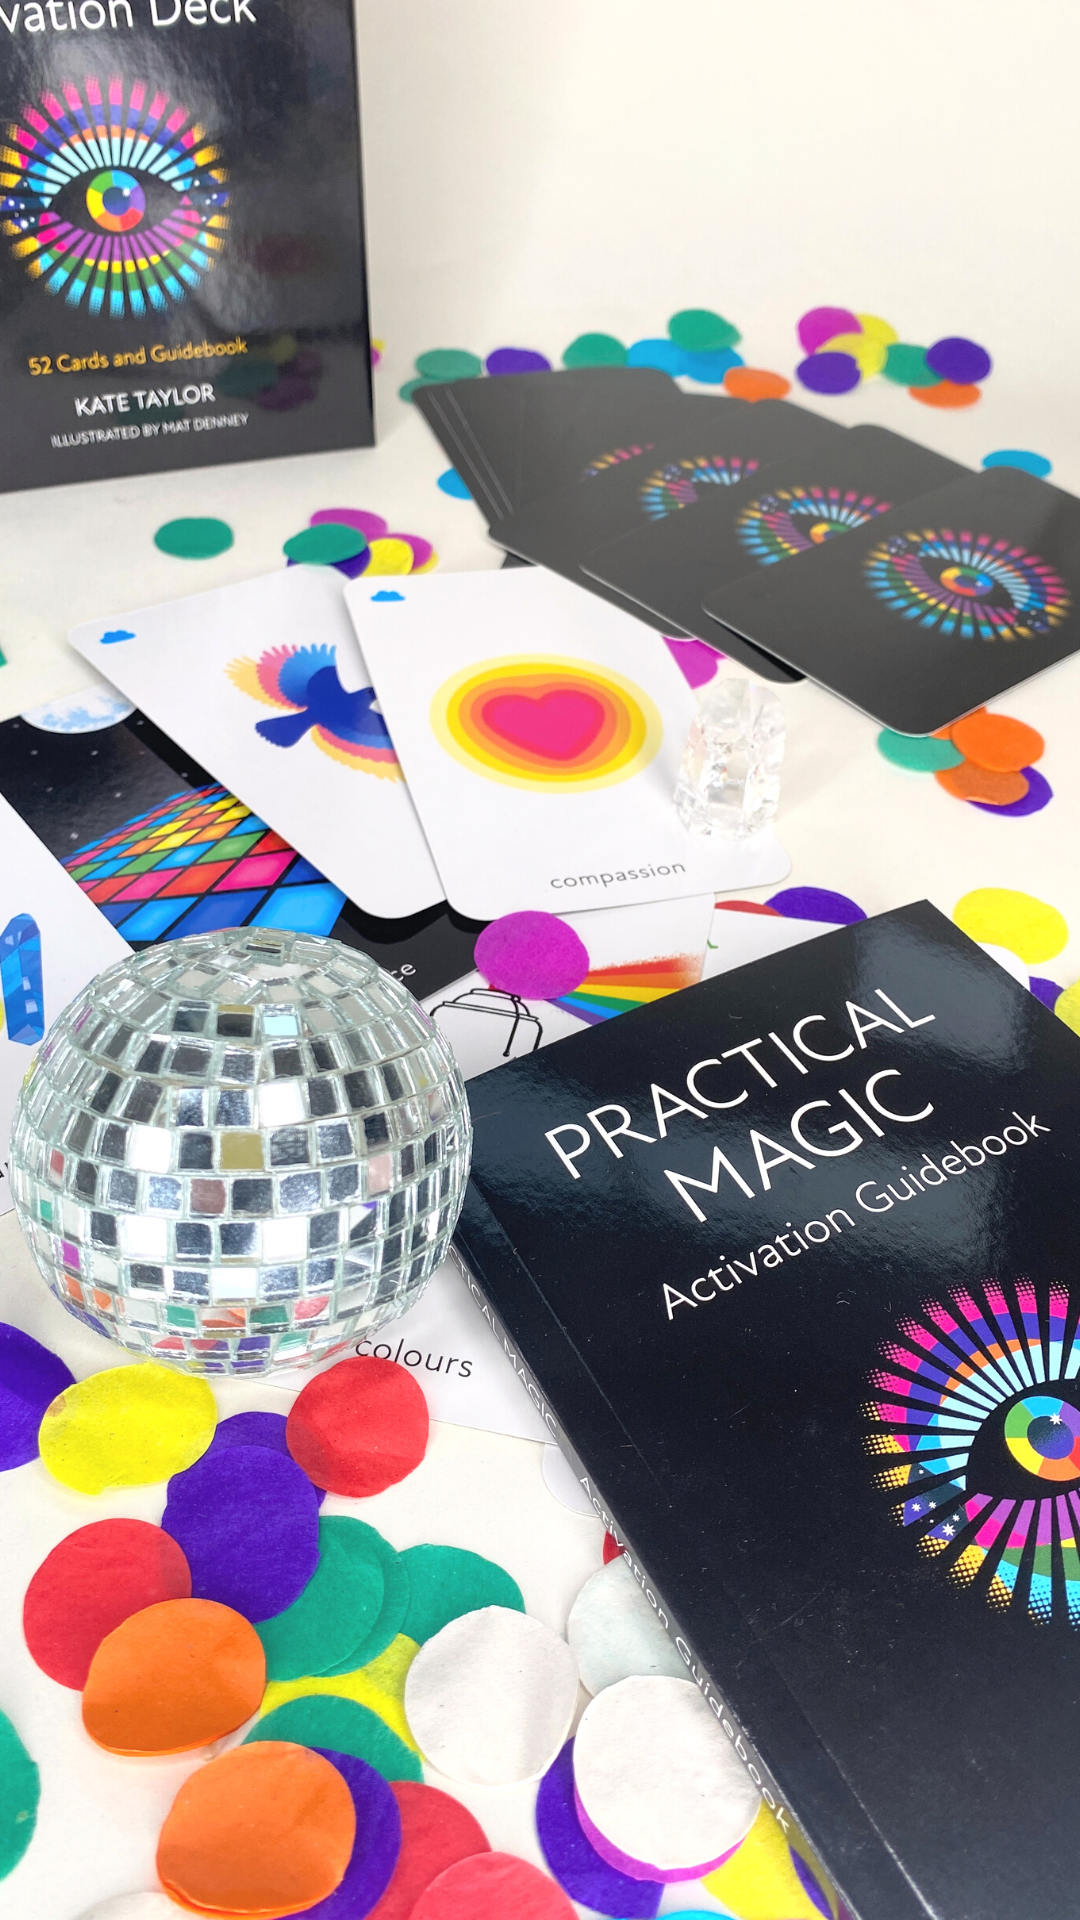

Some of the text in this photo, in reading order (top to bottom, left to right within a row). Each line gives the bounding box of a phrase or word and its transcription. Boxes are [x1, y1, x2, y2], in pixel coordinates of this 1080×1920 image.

[150, 0, 256, 26] Deck
[28, 335, 248, 376] 52 Cards and Guidebook
[74, 382, 216, 417] KATE TAYLOR
[50, 411, 249, 449] ILLUSTRATED BY MAT DENNEY
[550, 863, 686, 888] compassion
[544, 988, 936, 1180] PRACTICAL
[663, 1068, 934, 1223] MAGIC
[660, 1110, 1052, 1321] Activation Guidebook
[355, 1338, 473, 1378] colours
[503, 1336, 558, 1438] MAGIC
[579, 1475, 670, 1630] Activation
[674, 1635, 790, 1835] Guidebook
